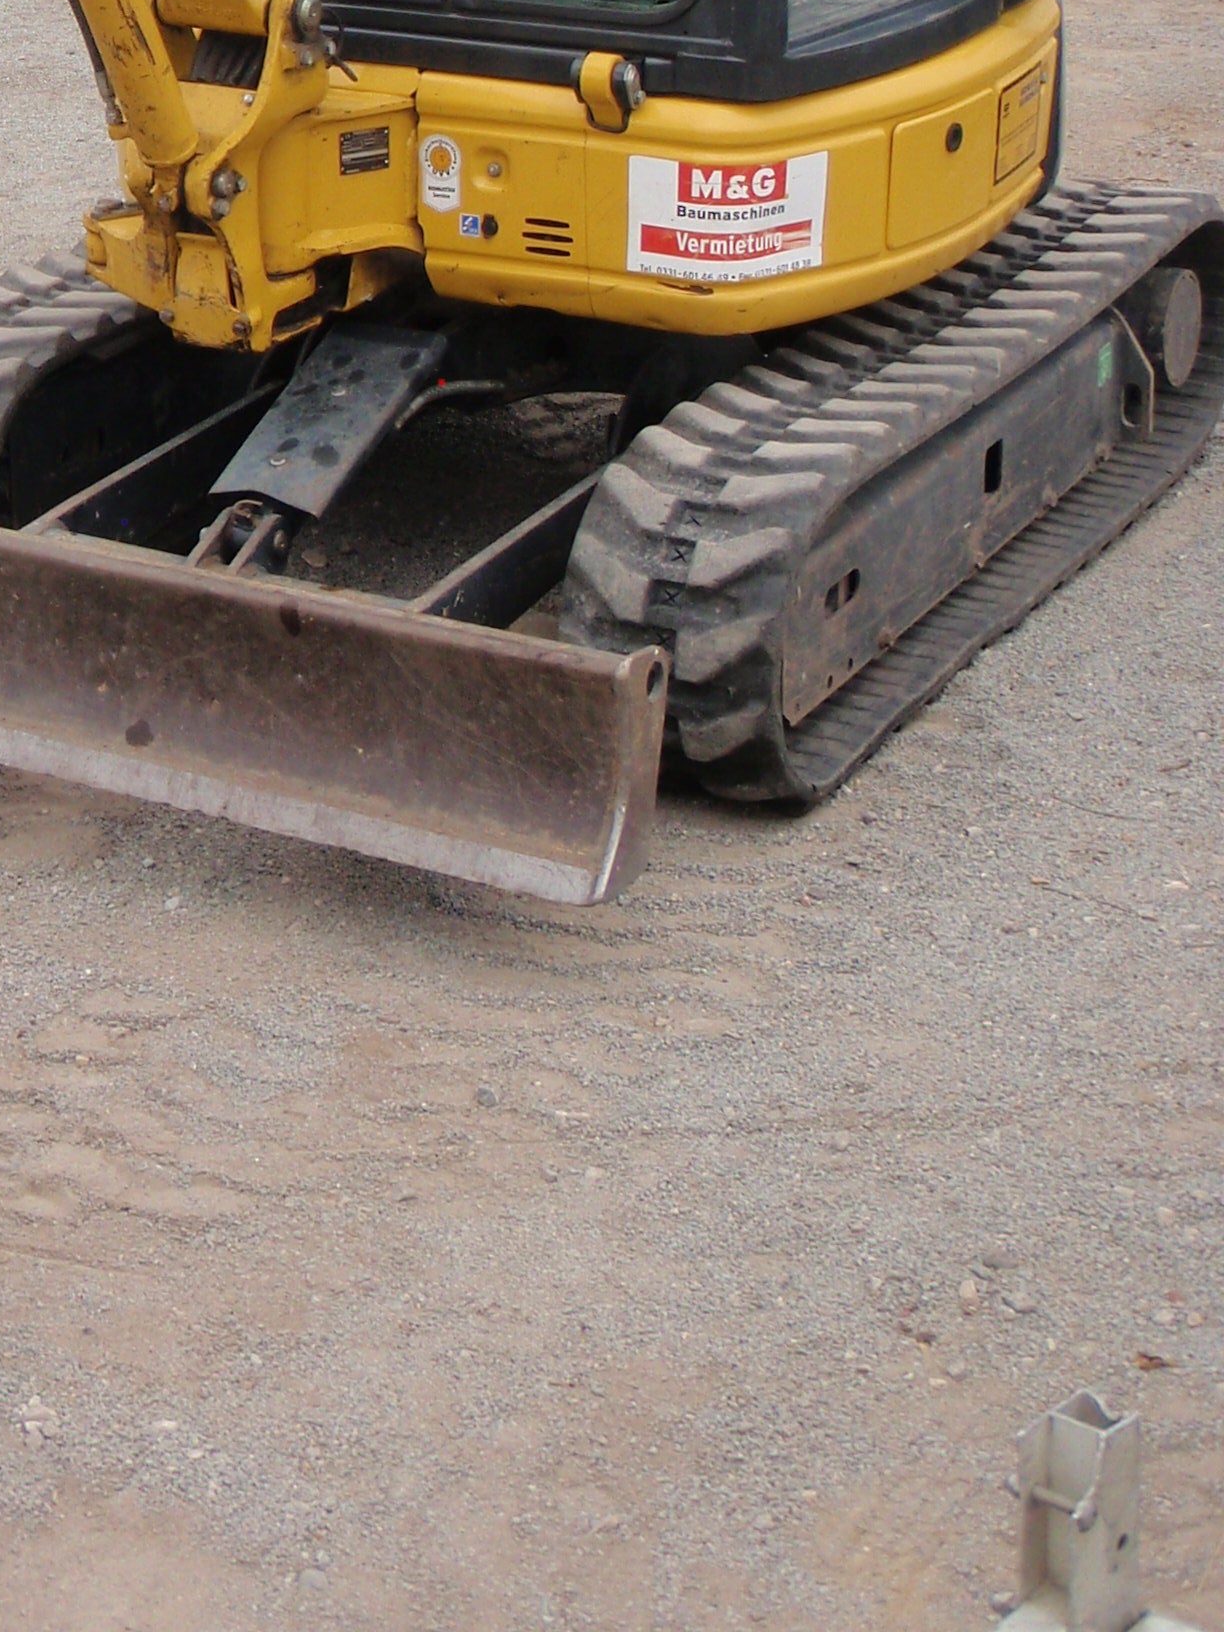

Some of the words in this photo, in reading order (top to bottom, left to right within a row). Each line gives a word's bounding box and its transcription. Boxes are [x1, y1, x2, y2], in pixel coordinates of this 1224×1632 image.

[690, 166, 776, 200] M&G
[676, 203, 786, 221] Baumaschinen
[676, 230, 783, 255] Vermietung
